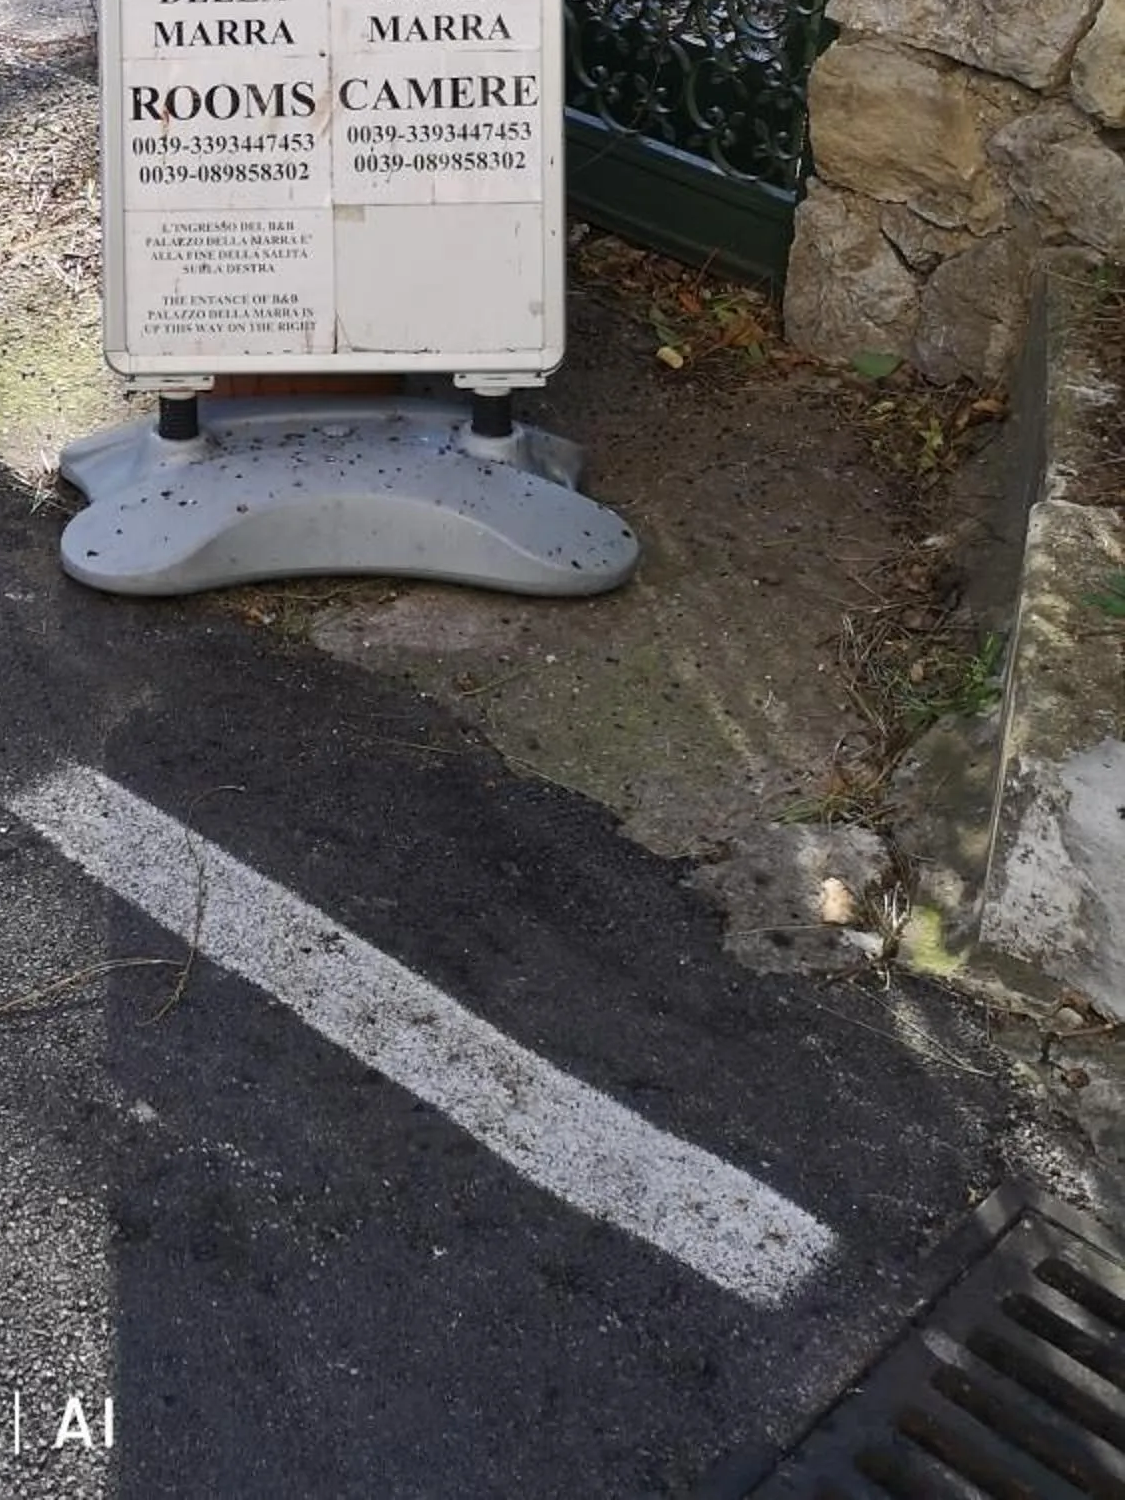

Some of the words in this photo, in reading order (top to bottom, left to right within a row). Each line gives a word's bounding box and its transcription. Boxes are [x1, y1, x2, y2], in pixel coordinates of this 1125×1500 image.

[154, 19, 295, 47] MARRA
[367, 13, 511, 42] MARRA
[129, 81, 316, 122] ROOMS
[339, 75, 539, 111] CAMERE
[132, 132, 315, 156] 0039-3393447453
[347, 122, 533, 145] 0039-3393447453
[139, 162, 309, 185] 0039-089858302
[354, 151, 526, 173] 0039-089858302
[146, 237, 204, 247] PALAZZO
[206, 236, 247, 246] DELLA
[250, 235, 297, 245] MARRA
[219, 250, 260, 260] DELLA
[226, 263, 275, 273] DESTRA
[147, 310, 206, 320] PALAZZO
[209, 308, 250, 319] DELLA
[253, 308, 300, 318] MARRA
